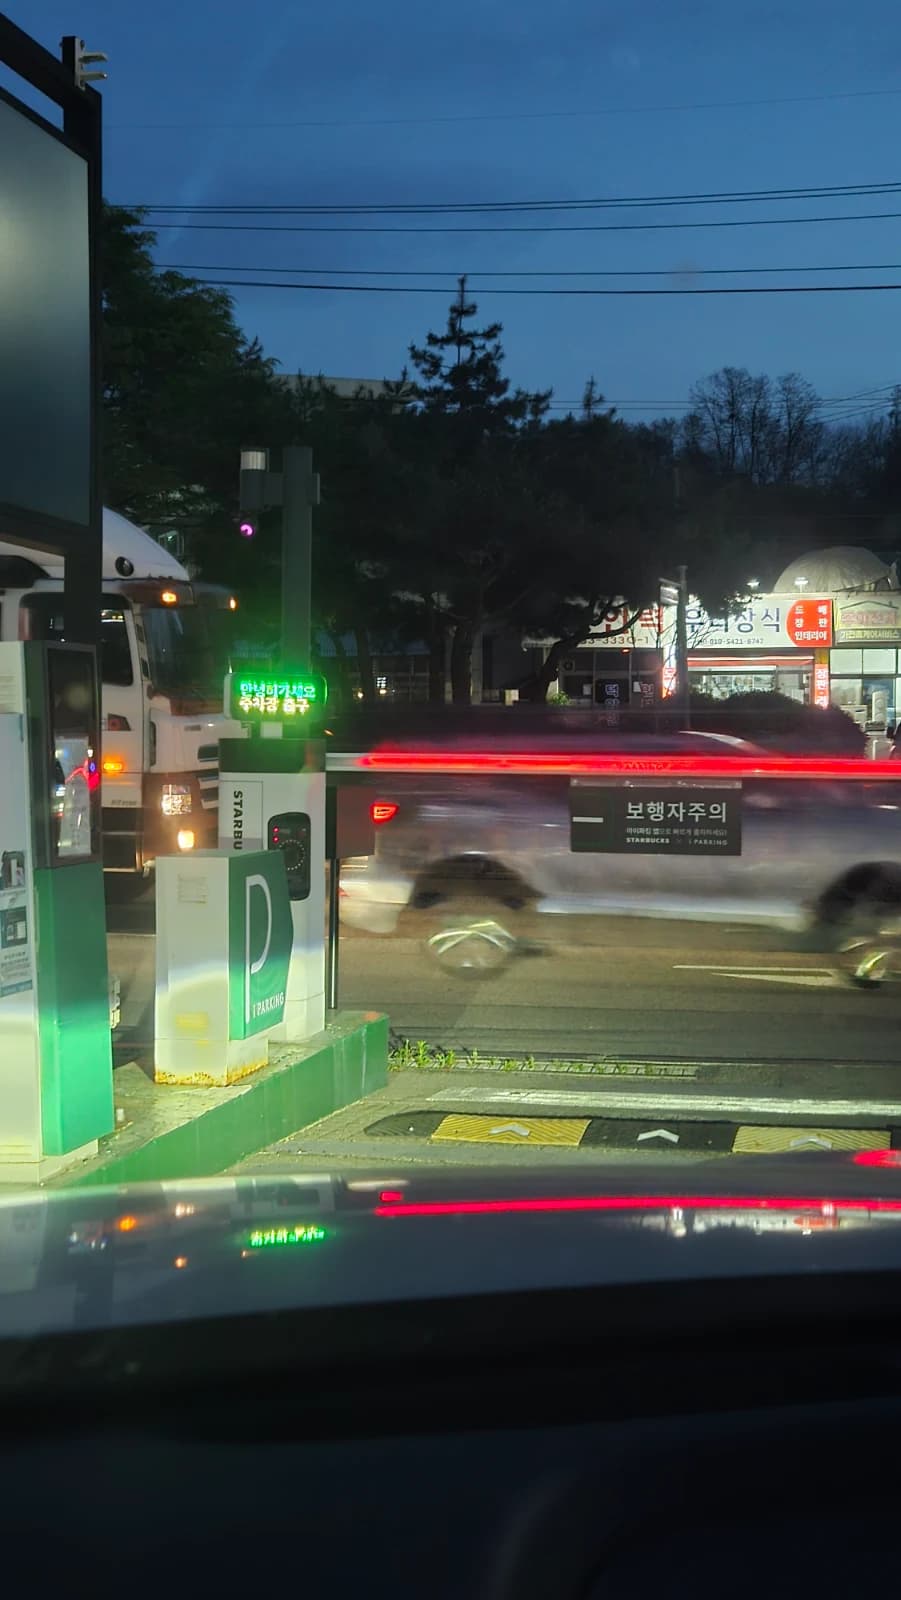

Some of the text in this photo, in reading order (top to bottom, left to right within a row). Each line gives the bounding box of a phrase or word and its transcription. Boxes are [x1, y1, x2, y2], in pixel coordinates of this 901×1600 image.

[794, 631, 827, 641] 인테리어
[239, 681, 316, 698] 안녕히가세요
[238, 696, 310, 714] 주차장 출구
[625, 801, 727, 823] 보행자주의
[257, 991, 285, 1016] PARKING
